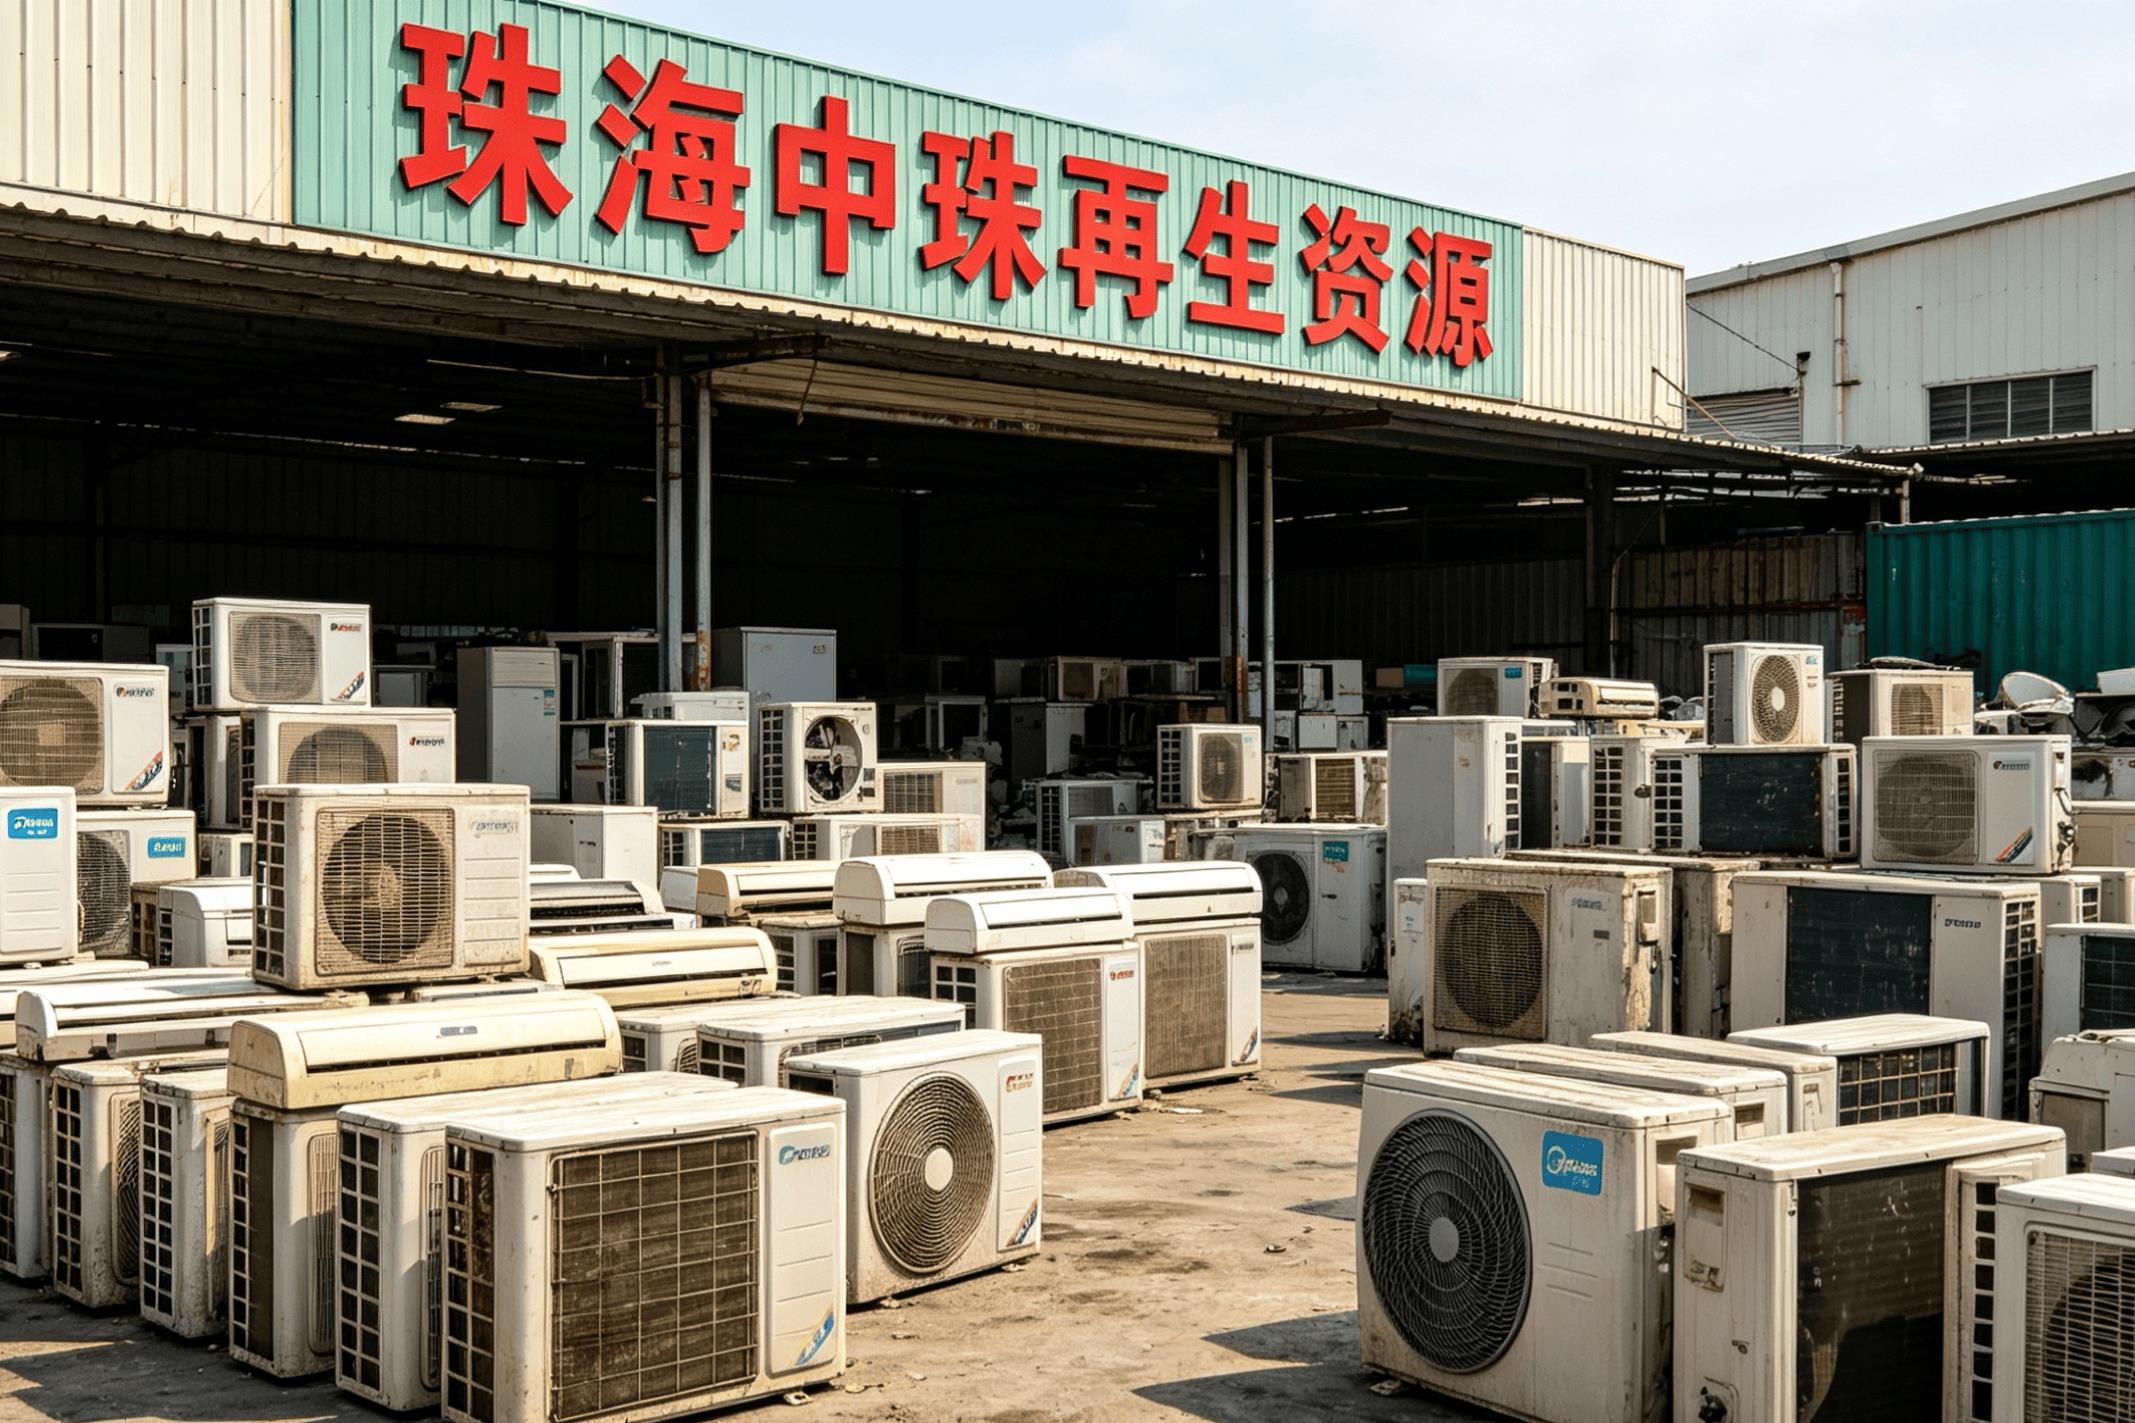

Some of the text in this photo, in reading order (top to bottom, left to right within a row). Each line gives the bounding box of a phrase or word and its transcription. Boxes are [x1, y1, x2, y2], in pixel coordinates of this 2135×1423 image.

[402, 24, 1491, 365] 珠海中珠再生资源
